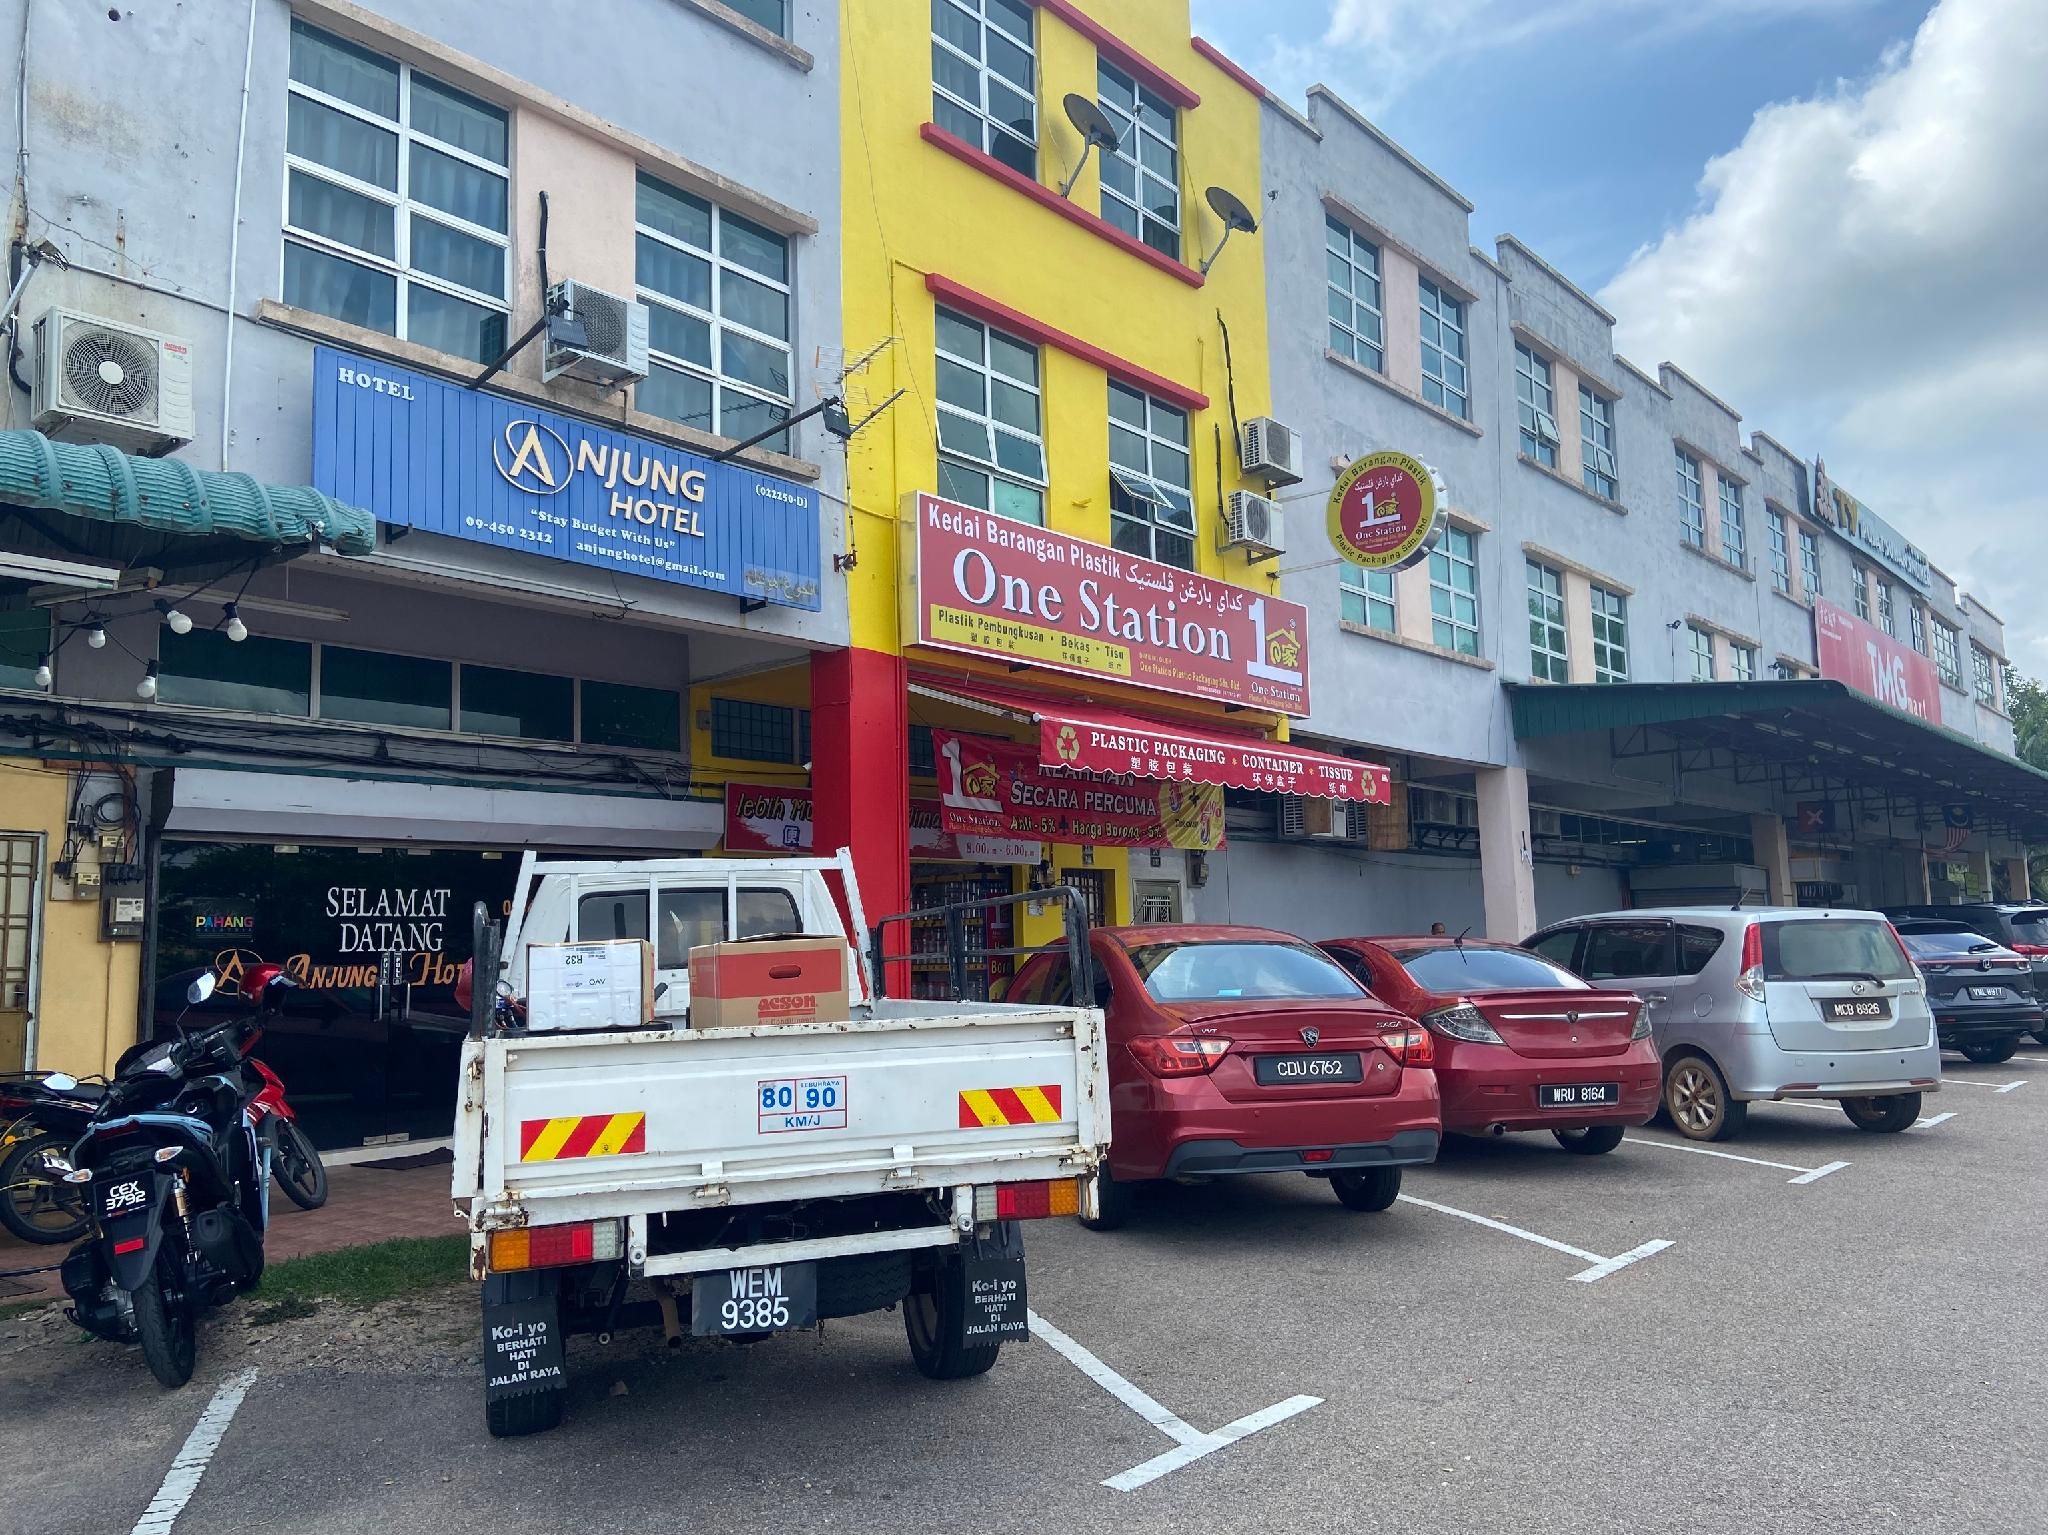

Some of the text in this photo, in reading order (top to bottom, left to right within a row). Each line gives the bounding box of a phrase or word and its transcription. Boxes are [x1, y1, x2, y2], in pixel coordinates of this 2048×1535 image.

[339, 367, 415, 400] HOTEL
[1352, 456, 1397, 477] Barangan
[1400, 457, 1428, 486] Plastik
[610, 491, 705, 537] HOTEL
[465, 516, 553, 544] 09-450 2312
[571, 517, 617, 537] Budget
[620, 528, 651, 546] With
[928, 502, 1121, 578] Kedai Barangan Plastik
[1355, 525, 1407, 540] One Station
[1335, 533, 1355, 556] Plastic
[1357, 550, 1401, 564] Packaging
[576, 541, 726, 581] anjunghotel@gmail.com
[953, 547, 1232, 661] One Station
[938, 609, 1124, 660] Plastik Pembungkusan Bekas Tisu
[1251, 681, 1269, 695] One
[1270, 686, 1300, 702] Station
[1091, 732, 1354, 781] PLASTIC PACKAGING CONTAINER TISSUE
[1130, 755, 1193, 776] 塑胶包装
[1010, 780, 1157, 816] SECARA PERCUMA
[1041, 817, 1056, 832] 5%
[1072, 820, 1102, 839] Harga
[326, 886, 451, 918] SELAMAT
[196, 915, 254, 928] PAHANG
[339, 922, 443, 953] DATANG
[409, 952, 465, 987] HOT
[566, 954, 583, 965] R32
[1834, 1002, 1880, 1016] MCB 8926
[1376, 1021, 1402, 1029] SAGA
[1277, 1060, 1342, 1076] CDU 6762
[762, 1086, 836, 1108] 80 90
[1554, 1086, 1605, 1102] WRU 8164
[785, 1115, 821, 1128] KM/J
[110, 1180, 140, 1198] CEX
[106, 1190, 146, 1210] 3792
[730, 1266, 782, 1298] WEM
[1001, 1280, 1016, 1292] yo
[974, 1293, 1016, 1304] BERHATI
[984, 1303, 1007, 1312] HATI
[721, 1296, 789, 1329] 9385
[990, 1313, 1000, 1322] DI
[528, 1321, 547, 1337] yo
[966, 1321, 1025, 1335] JALAN RAYA
[496, 1335, 547, 1352] BERHATI
[509, 1349, 537, 1361] HATI
[489, 1366, 561, 1387] JALAN RAYA
[517, 1361, 530, 1371] DI
